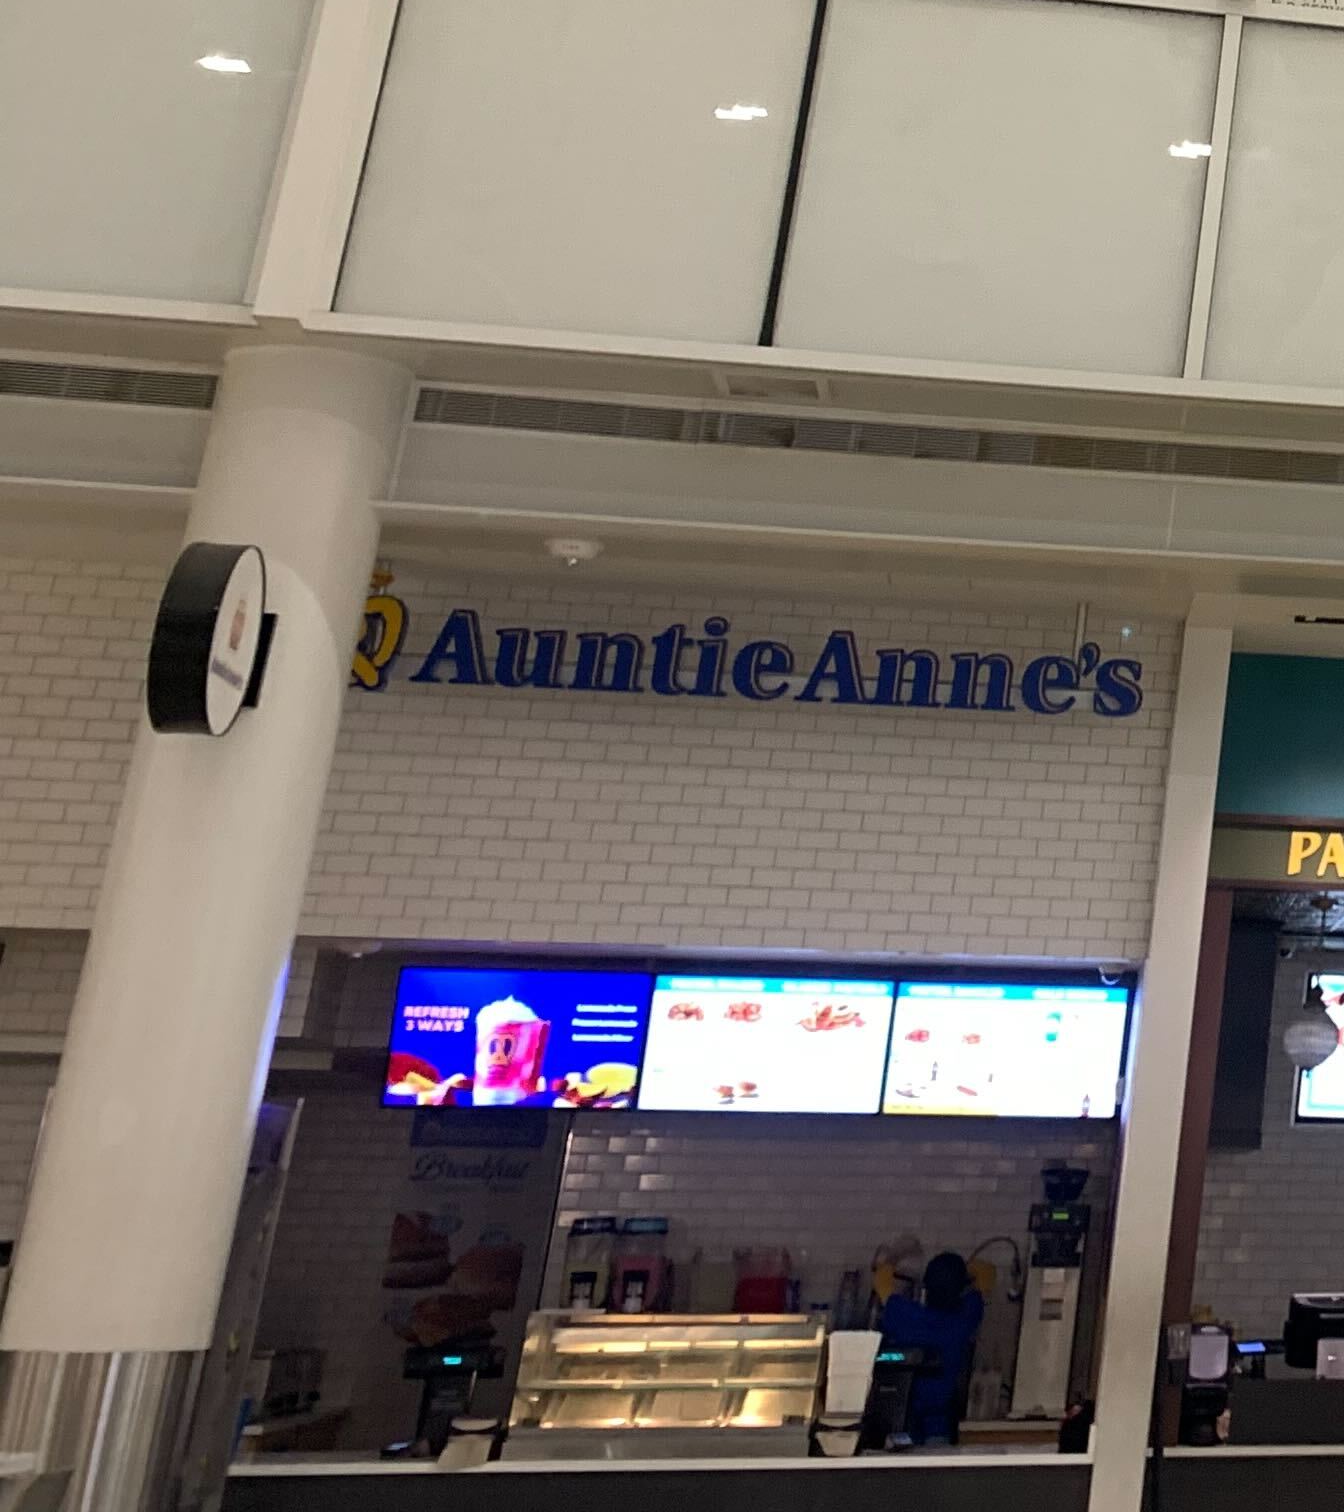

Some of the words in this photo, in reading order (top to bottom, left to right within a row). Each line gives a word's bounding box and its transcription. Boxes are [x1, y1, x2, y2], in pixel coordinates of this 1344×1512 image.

[410, 608, 794, 701] Auntie
[795, 628, 1143, 719] Anne's
[403, 1005, 470, 1020] REFRESH
[417, 1020, 465, 1033] WAYS
